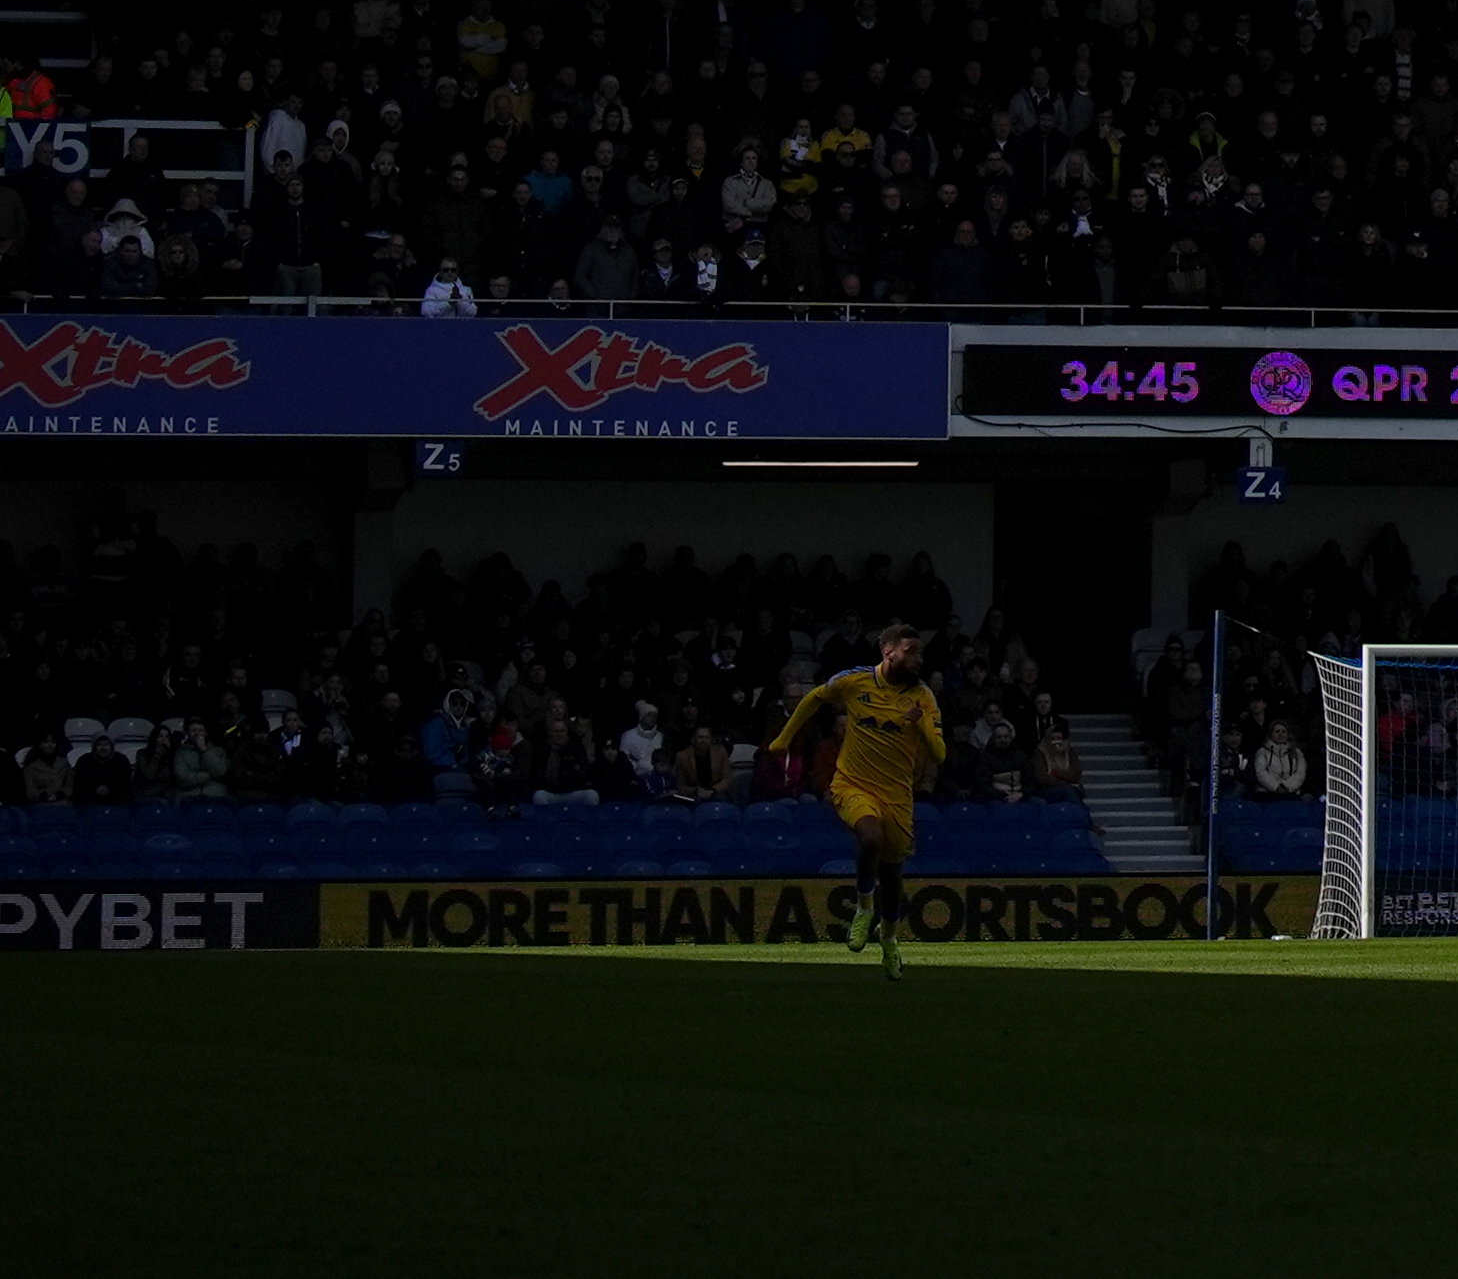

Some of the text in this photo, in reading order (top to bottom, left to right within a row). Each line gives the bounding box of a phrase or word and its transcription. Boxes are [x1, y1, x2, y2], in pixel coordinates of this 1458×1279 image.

[7, 122, 91, 175] Y5
[472, 322, 770, 423] Xtra
[1060, 360, 1200, 403] 34:45
[1331, 364, 1429, 403] QPR
[4, 415, 219, 433] AINTENANCE
[504, 419, 739, 436] MAINTENANCE
[423, 443, 461, 472] Z5
[1244, 471, 1283, 499] Z4
[368, 888, 570, 947] MORE
[579, 885, 757, 945] THAN
[825, 882, 1279, 942] SORTSBOOK
